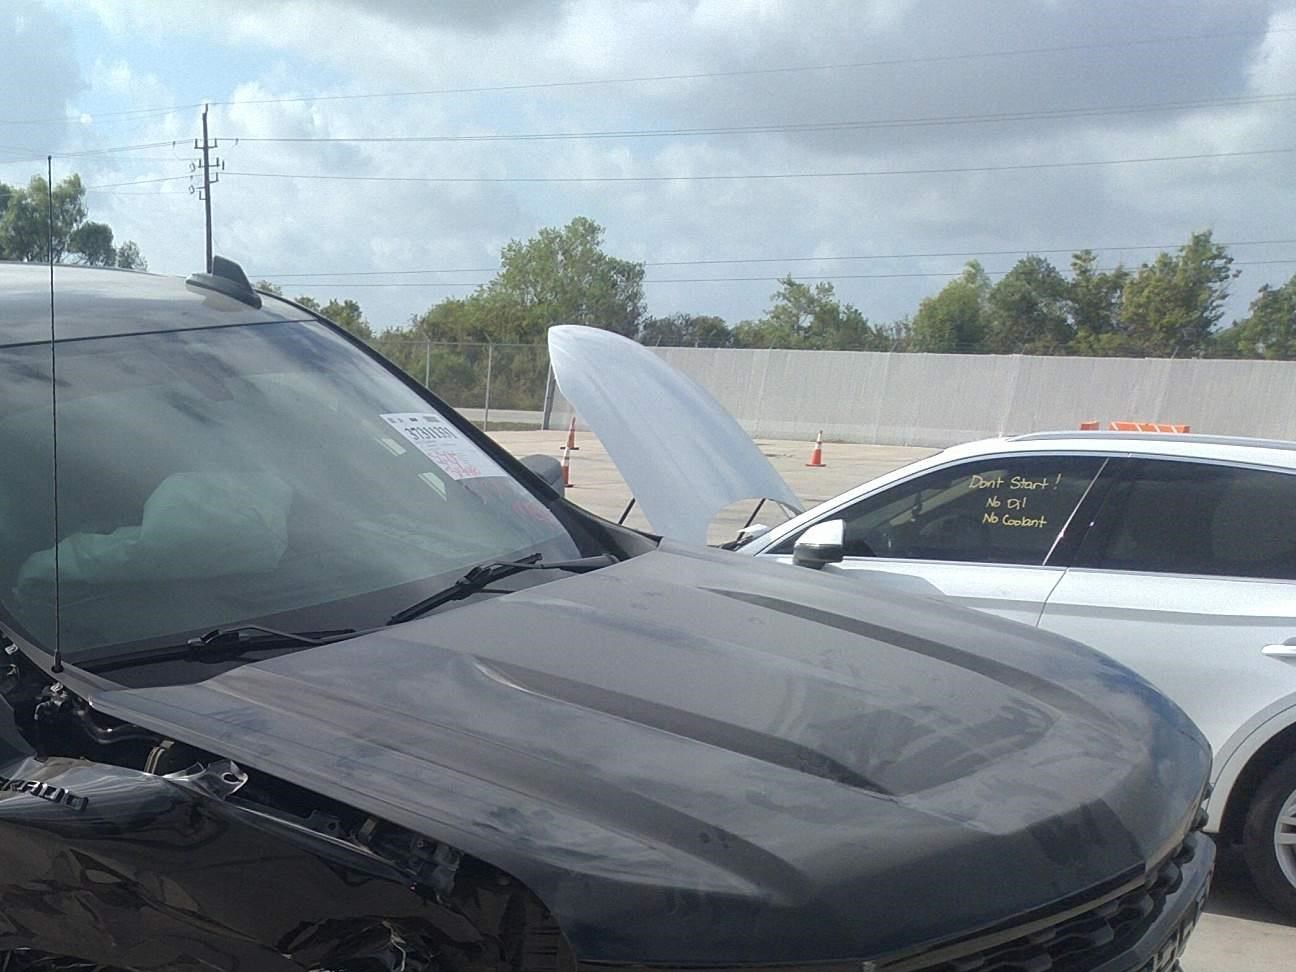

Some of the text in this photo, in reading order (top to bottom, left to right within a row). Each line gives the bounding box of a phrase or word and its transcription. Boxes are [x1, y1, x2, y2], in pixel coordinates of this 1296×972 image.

[986, 495, 1001, 508] No
[982, 512, 1048, 528] No Coolant
